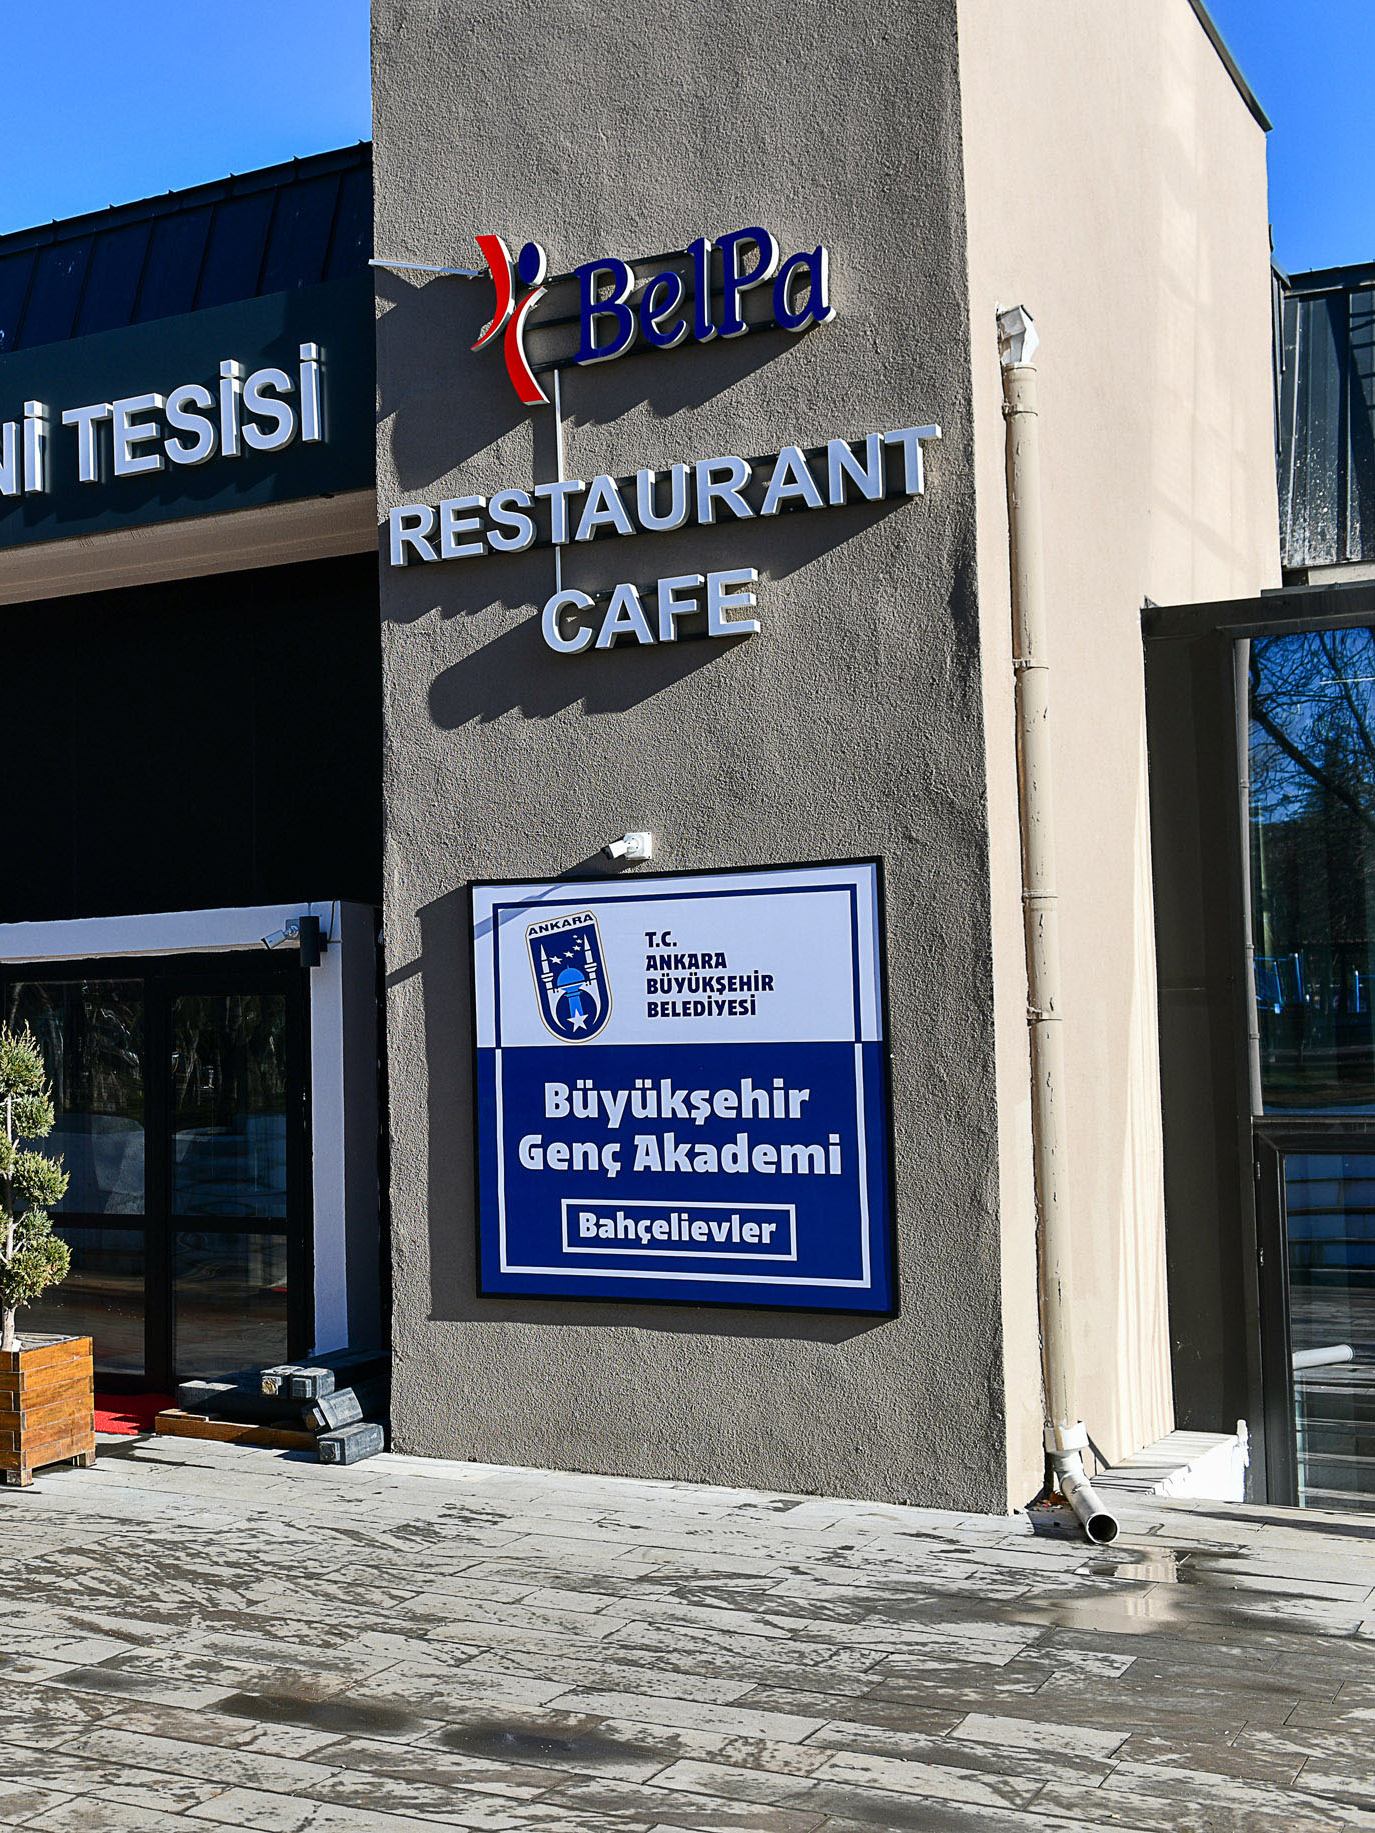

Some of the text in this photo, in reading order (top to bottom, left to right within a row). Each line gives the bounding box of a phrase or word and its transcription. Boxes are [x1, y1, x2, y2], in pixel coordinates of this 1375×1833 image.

[575, 227, 836, 364] BelPa
[61, 343, 322, 482] TESİSİ
[389, 424, 942, 567] RESTAURANT
[541, 568, 761, 655] CAFE
[527, 913, 594, 937] ANKARA
[645, 931, 678, 948] T.C.
[645, 952, 727, 972] ANKARA
[646, 970, 775, 995] BÜYÜKŞEHİR
[646, 994, 757, 1018] BELEDİYESİ
[544, 1078, 810, 1128] Büyükşehir
[518, 1133, 842, 1177] Genç Akademi
[578, 1211, 777, 1244] Bahçelievler
